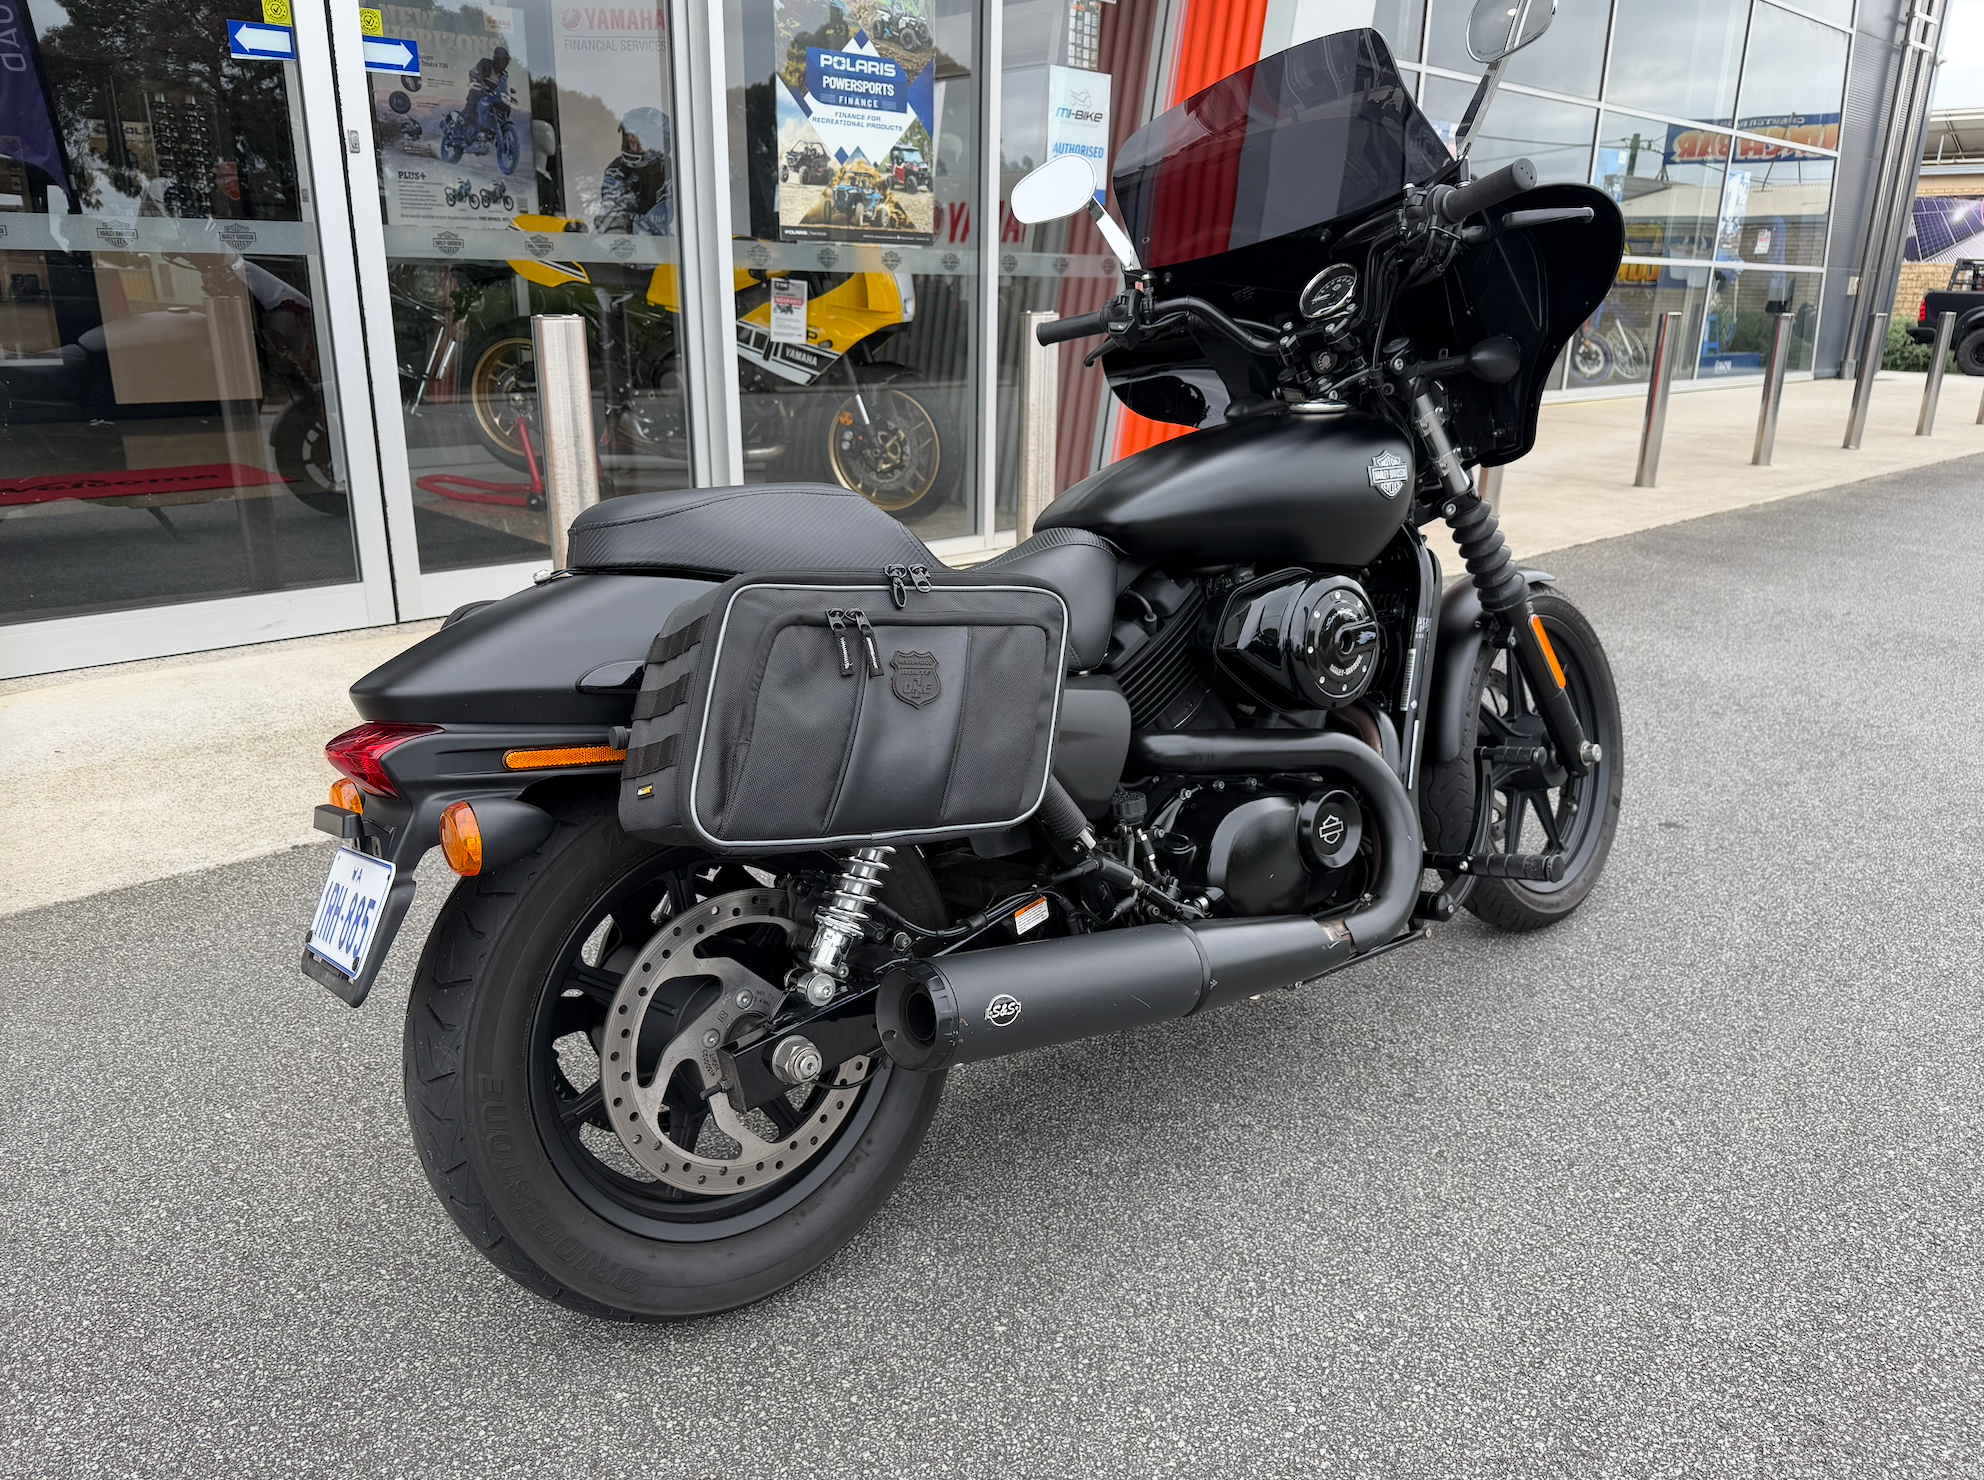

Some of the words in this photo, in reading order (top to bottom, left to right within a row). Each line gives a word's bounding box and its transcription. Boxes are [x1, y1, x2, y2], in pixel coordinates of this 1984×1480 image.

[379, 4, 435, 29] NEW
[584, 8, 666, 31] YAMAHA
[565, 39, 618, 52] FINANCIAL
[620, 40, 667, 52] SERVICES
[820, 54, 896, 77] POLARIS
[822, 75, 895, 97] POWERSPORTS
[838, 95, 879, 108] FINANCE
[812, 116, 865, 128] RECREATIONAL
[866, 123, 903, 132] PRODUCTS
[834, 111, 865, 121] FINANCE
[1052, 142, 1104, 159] AUTHORISED
[398, 171, 427, 180] PLUS+
[785, 347, 818, 366] YAMAHA
[351, 866, 364, 884] WA
[991, 1001, 1016, 1019] S&S
[478, 1073, 649, 1293] BRIDGESTONE
